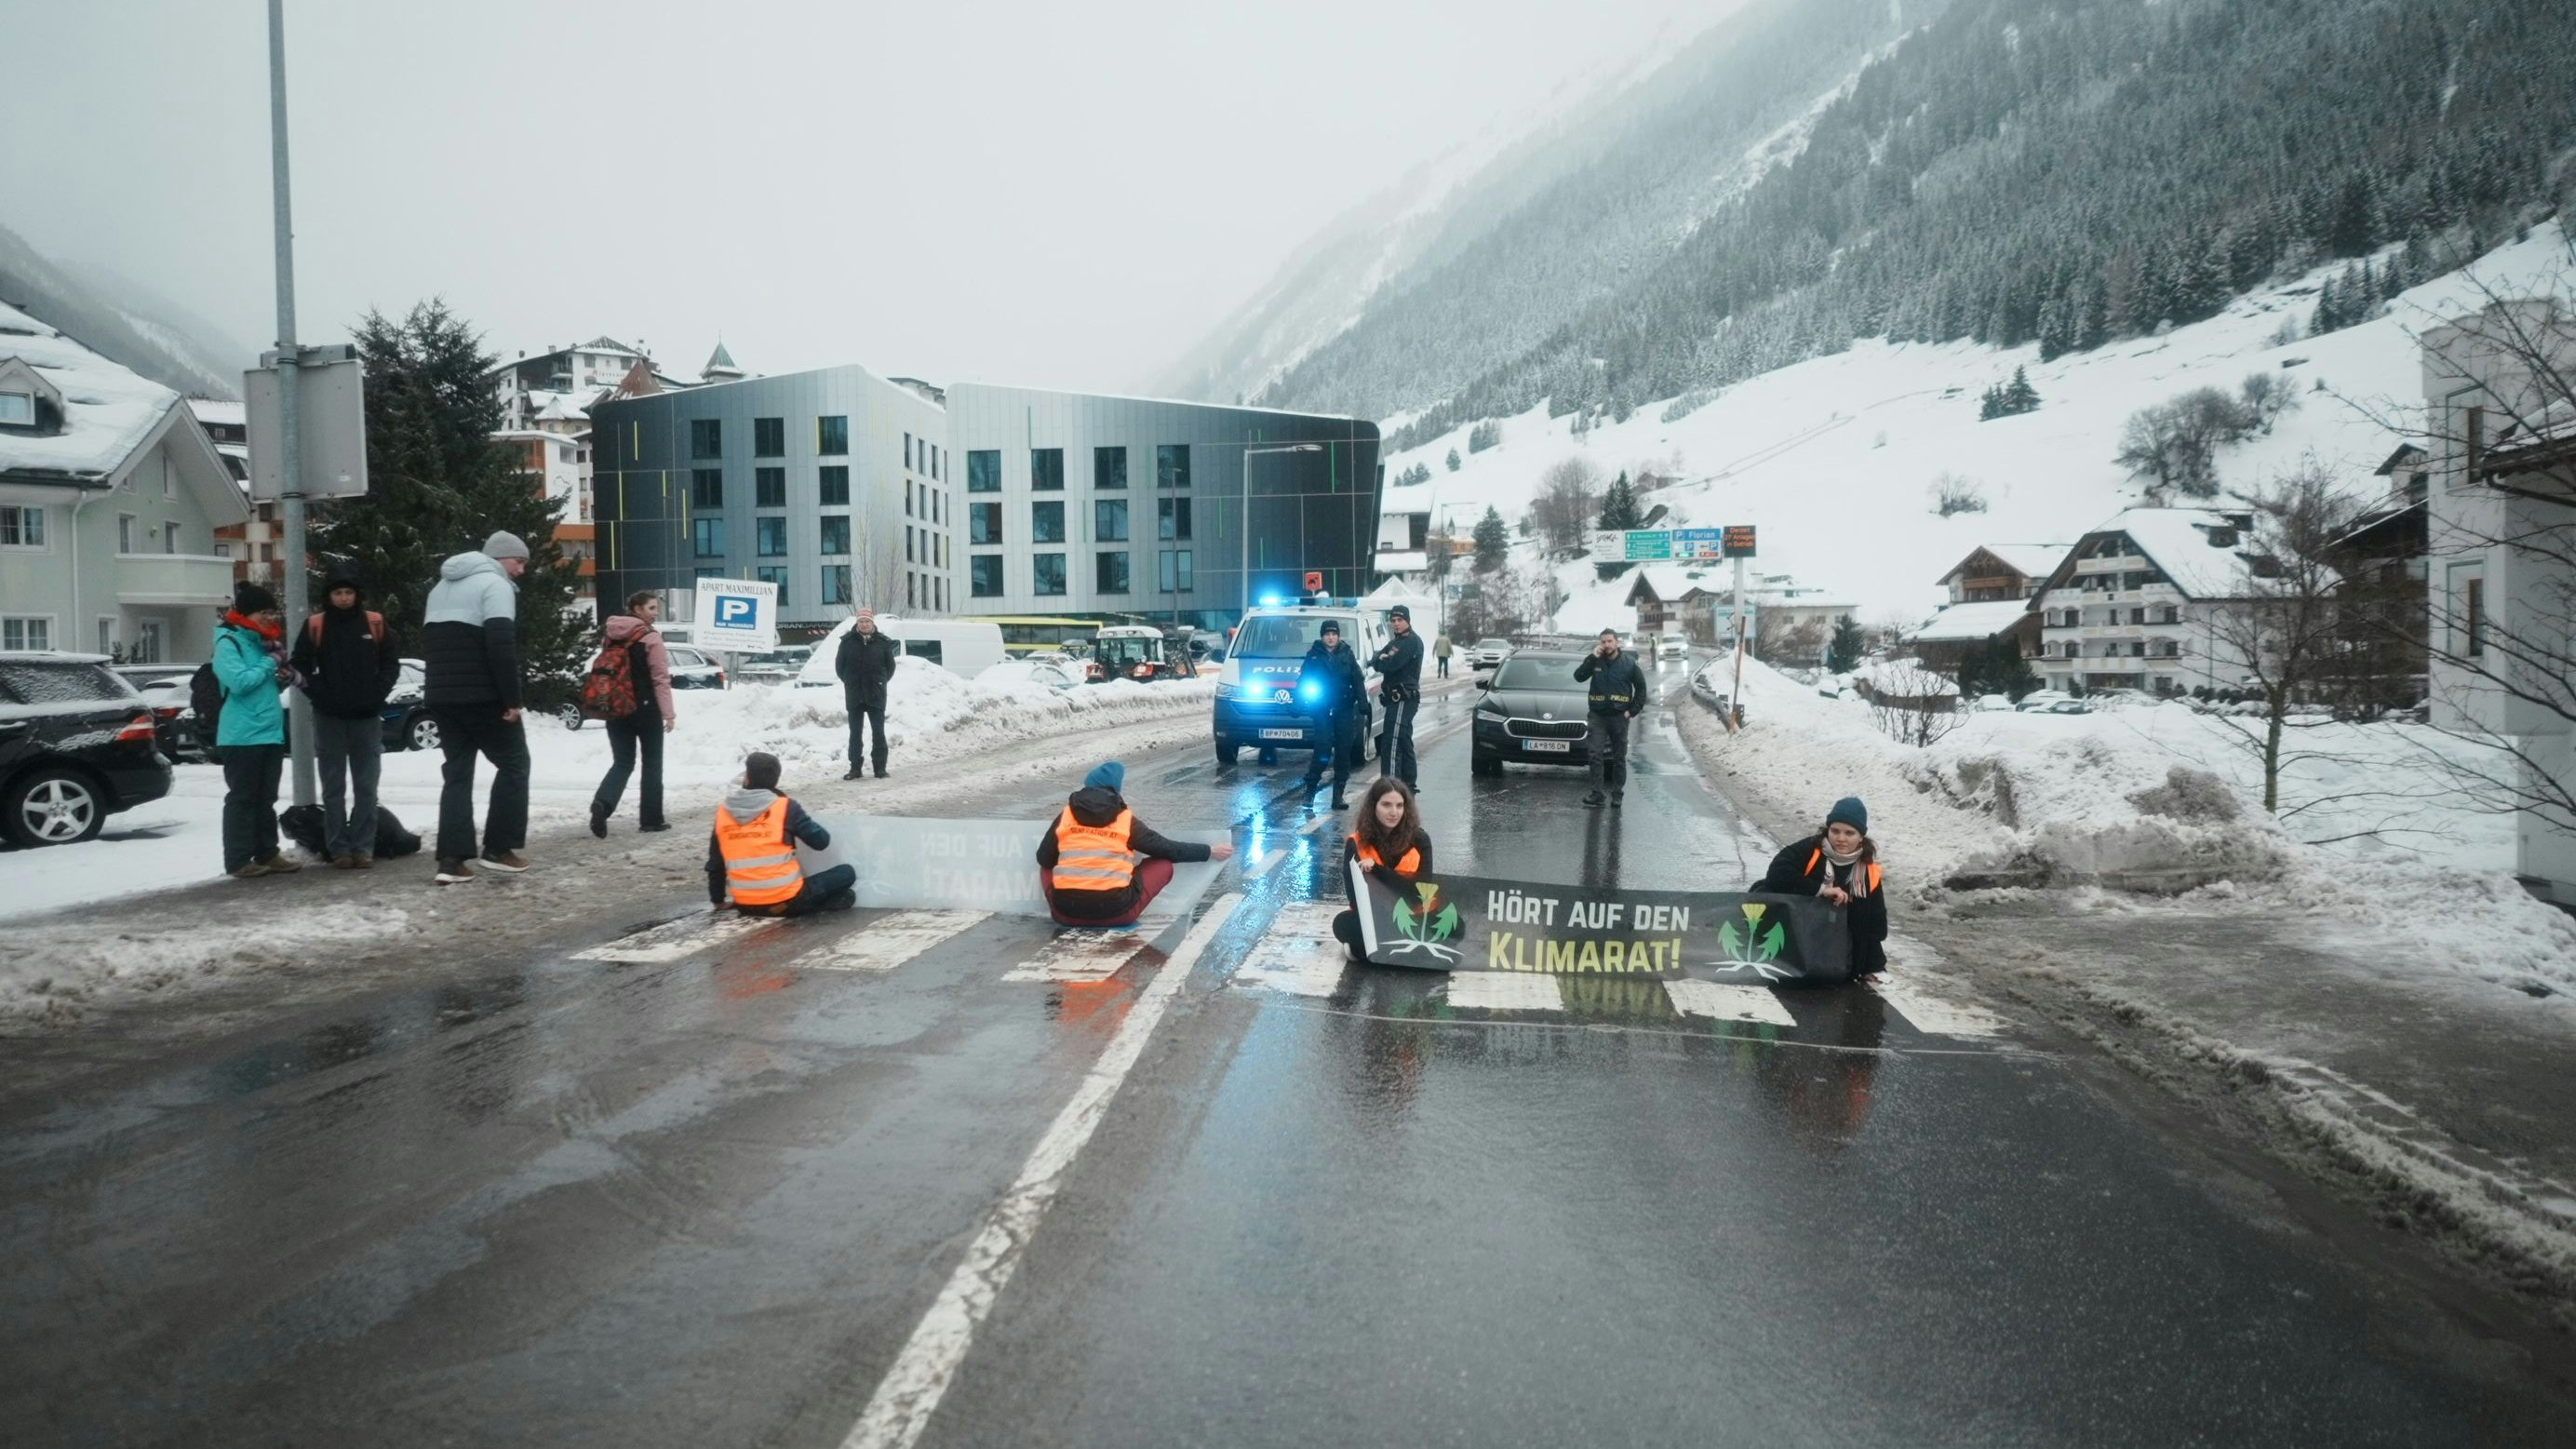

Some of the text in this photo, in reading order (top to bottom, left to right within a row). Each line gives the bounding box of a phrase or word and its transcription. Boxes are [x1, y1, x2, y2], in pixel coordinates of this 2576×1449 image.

[1688, 530, 1715, 539] Florian
[701, 583, 773, 596] APART MAXIMILLIAN
[723, 599, 749, 621] P
[1488, 889, 1690, 932] HÖRT AUF DEN
[1488, 931, 1682, 973] KLIMARAT!
